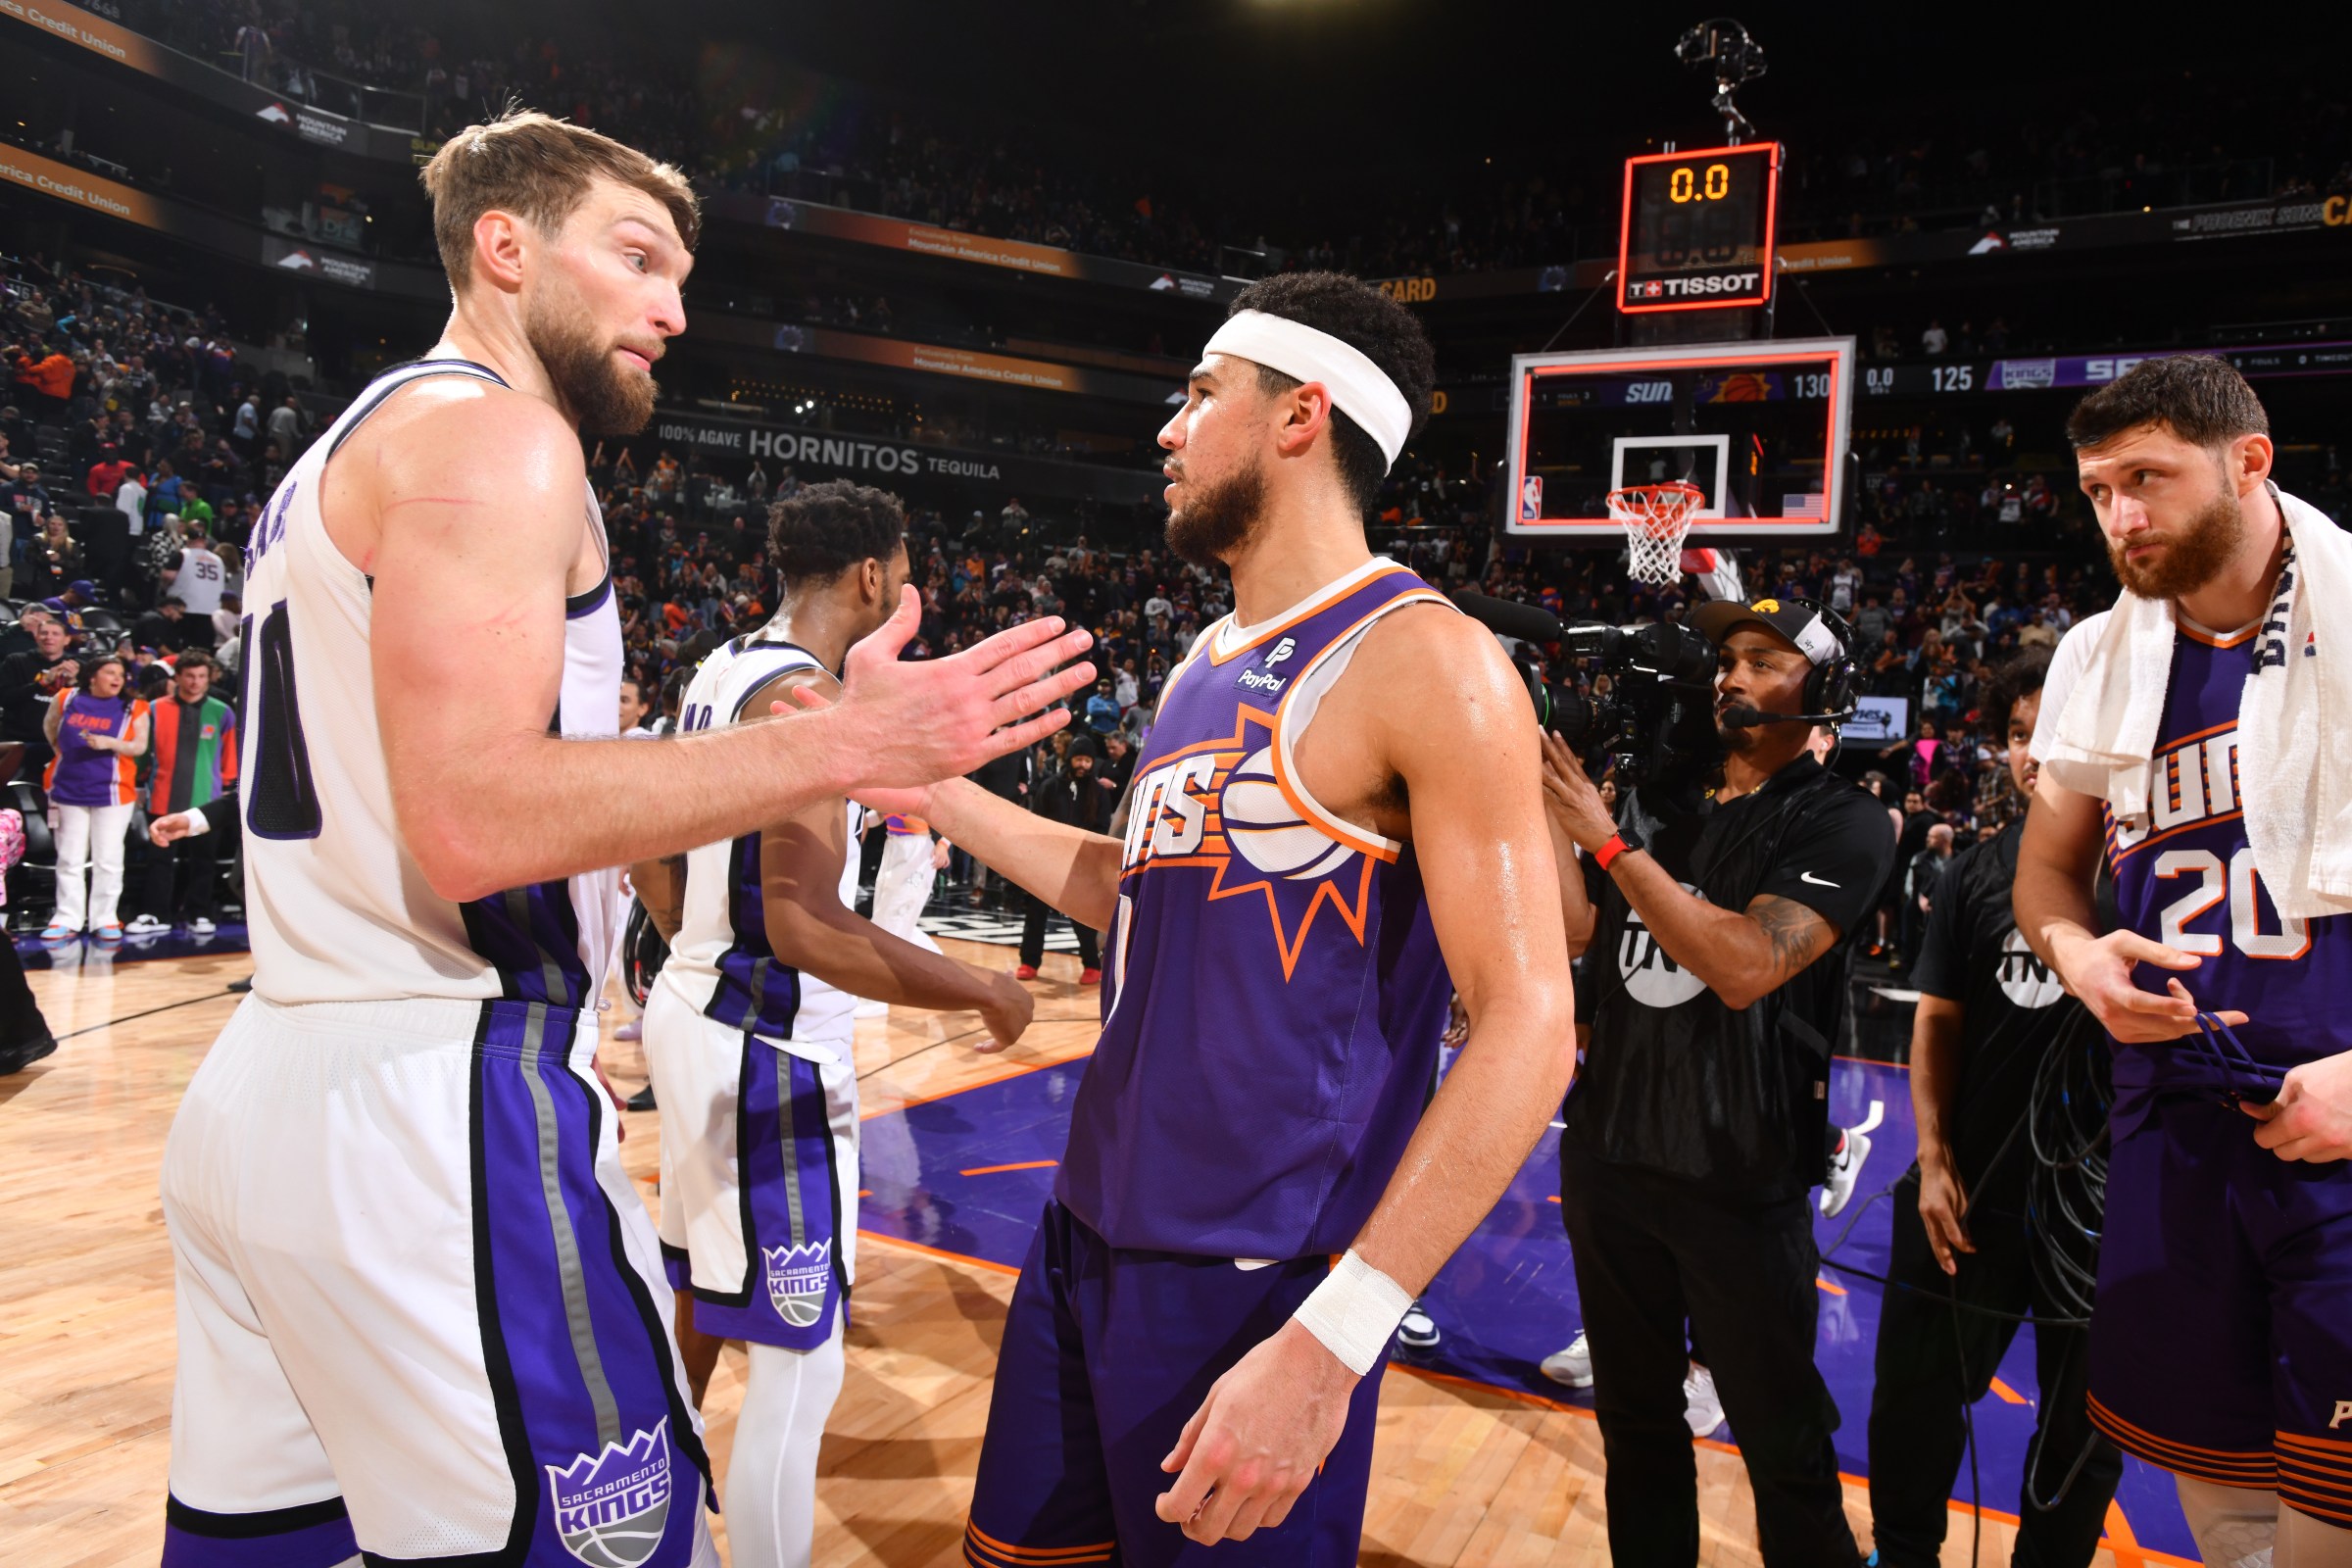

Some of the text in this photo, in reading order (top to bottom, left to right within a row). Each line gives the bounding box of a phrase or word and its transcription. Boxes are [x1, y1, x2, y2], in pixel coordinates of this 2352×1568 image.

[27, 8, 78, 38] Credit
[80, 30, 125, 59] Union
[296, 113, 347, 136] MOUNTAIN
[298, 123, 343, 143] AMERICA
[37, 175, 85, 201] Credit
[88, 192, 130, 216] Union
[1670, 163, 1730, 204] 0.0
[2191, 207, 2276, 232] PHOENIX
[320, 256, 371, 275] MOUNTAIN
[907, 237, 1061, 272] Mountain America Credit Union
[1818, 256, 1852, 268] Union
[323, 265, 367, 281] AMERICA
[1664, 272, 1759, 296] TISSOT
[913, 357, 1062, 387] Mountain America Credit Union
[1866, 368, 1894, 387] 0.0
[1932, 366, 1973, 391] 125
[1793, 373, 1831, 400] 130
[659, 424, 1001, 480] 100% AGAVE HORNITOS TEQUILA
[195, 562, 219, 581] 35
[1237, 669, 1287, 692] PayPal
[2154, 849, 2312, 961] 20
[769, 1263, 829, 1277] SACRAMENTO
[770, 1275, 830, 1295] KINGS
[561, 1458, 665, 1506] SACRAMENTO
[559, 1475, 670, 1535] KINGS
